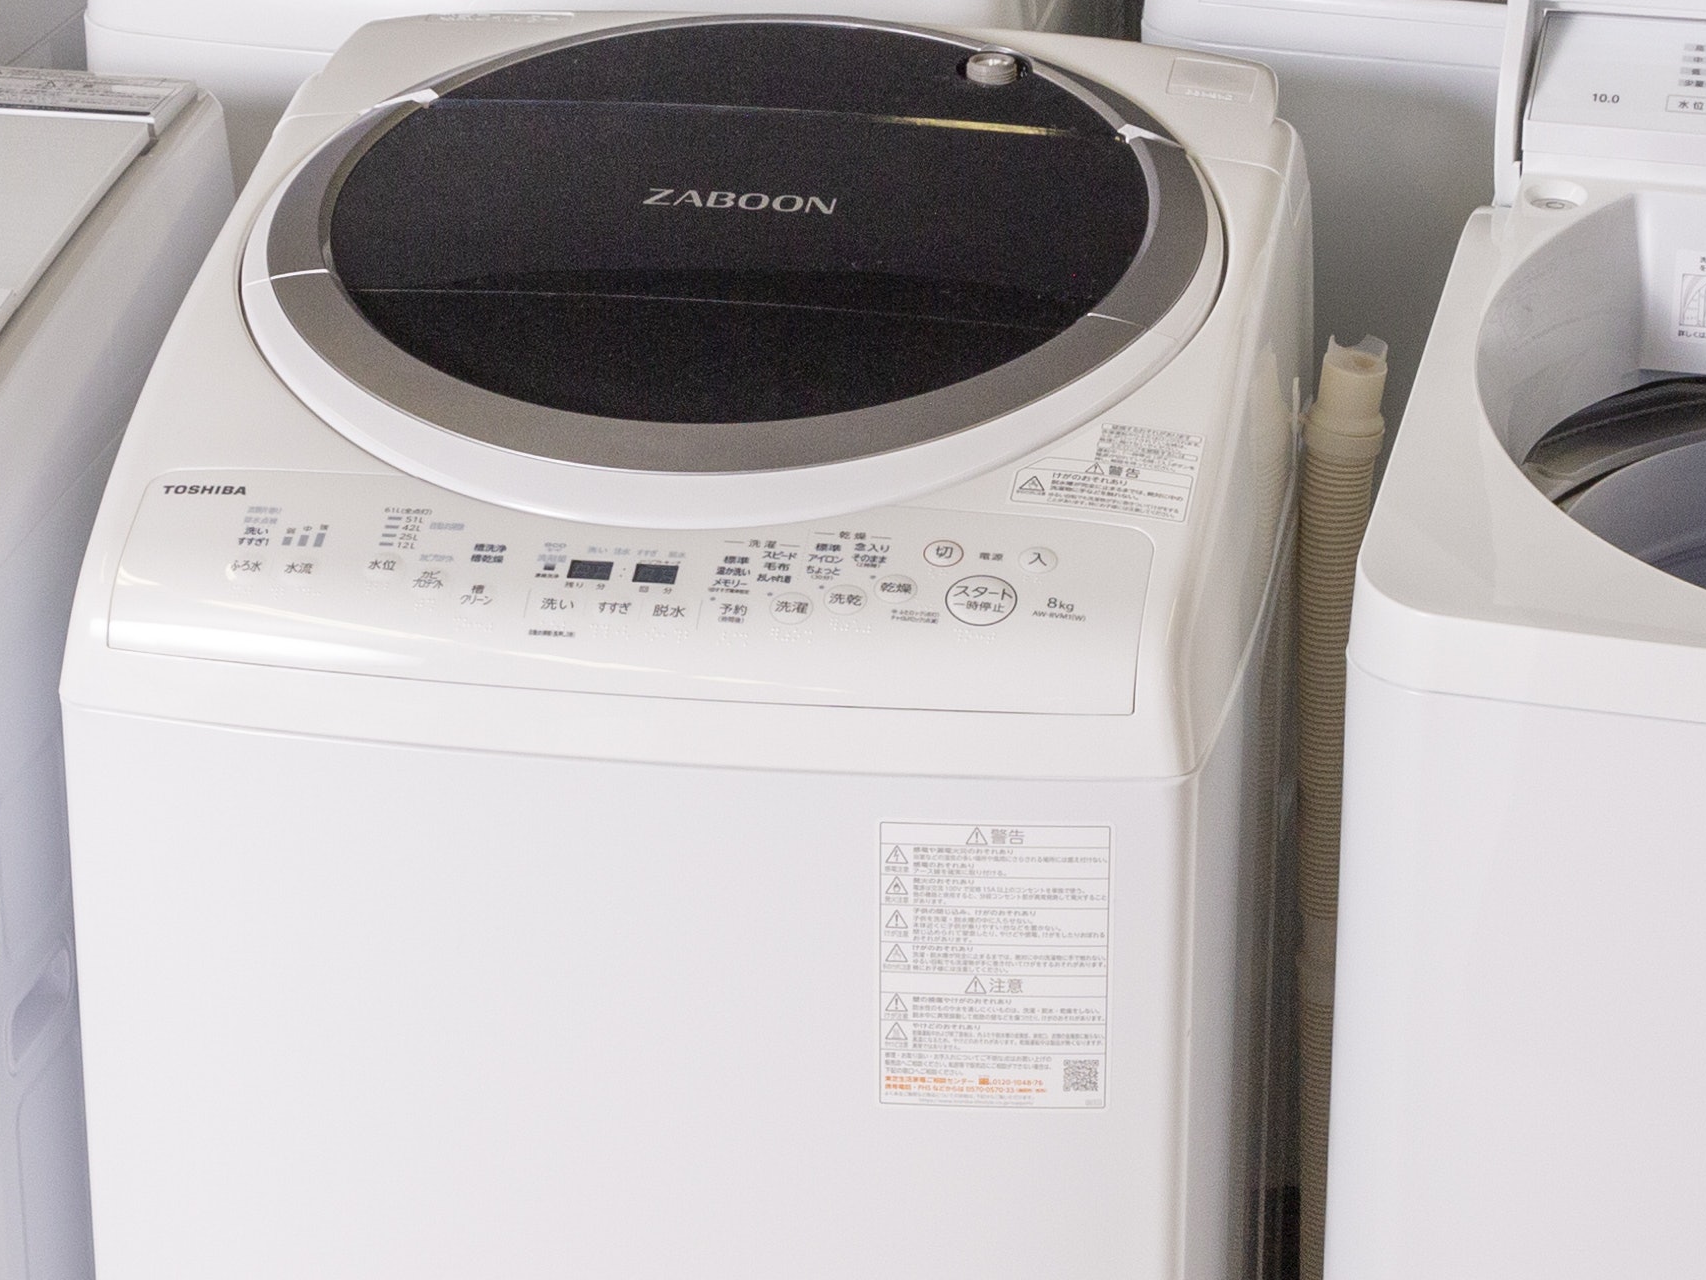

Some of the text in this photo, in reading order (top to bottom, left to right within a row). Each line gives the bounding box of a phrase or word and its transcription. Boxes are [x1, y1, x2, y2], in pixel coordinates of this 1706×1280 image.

[1591, 92, 1620, 104] 10.0
[1678, 100, 1704, 111] 水位
[642, 187, 838, 215] ZABOON
[1108, 465, 1141, 479] 警告
[1052, 471, 1128, 487] けがのおそれあり
[162, 484, 248, 496] TOSHIBA
[405, 515, 425, 524] 51L
[244, 526, 269, 535] 洗い
[401, 523, 422, 532] 42L
[399, 532, 419, 541] 25L
[839, 531, 867, 540] 乾燥
[396, 541, 417, 550] 12L
[473, 543, 507, 552] 槽洗浄
[749, 539, 778, 549] 洗濯
[815, 543, 842, 552] 標準
[854, 542, 890, 553] 念入り
[762, 551, 798, 561] スピード
[936, 545, 954, 559] 切
[979, 552, 1004, 562] 電源
[470, 553, 504, 563] 槽乾燥
[723, 555, 750, 564] 標準
[808, 554, 844, 564] アイロン
[852, 554, 887, 565] そのまま
[1028, 552, 1048, 566] 入
[231, 560, 262, 572] ふろ水
[283, 562, 313, 575] 水流
[368, 560, 396, 571] 水位
[716, 566, 751, 576] 温か洗い
[763, 562, 791, 572] 毛布
[806, 565, 842, 577] ちょっと
[421, 571, 442, 580] カビ
[757, 573, 792, 584] おしゃれ着
[713, 578, 748, 588] メモリー
[880, 582, 912, 595] 乾燥
[471, 585, 485, 594] 槽
[953, 585, 1013, 604] スタート
[460, 595, 493, 605] クリーン
[540, 598, 574, 610] 洗い
[829, 593, 863, 607] 洗乾
[1046, 596, 1075, 615] 8kg
[598, 601, 632, 615] すすぎ
[652, 604, 687, 619] 脱水
[719, 603, 748, 617] 予約
[775, 600, 809, 614] 洗濯
[953, 601, 1005, 617] 一時停止
[991, 828, 1025, 845] 警告
[912, 944, 974, 953] けがのおそれあり
[989, 977, 1024, 994] 注意
